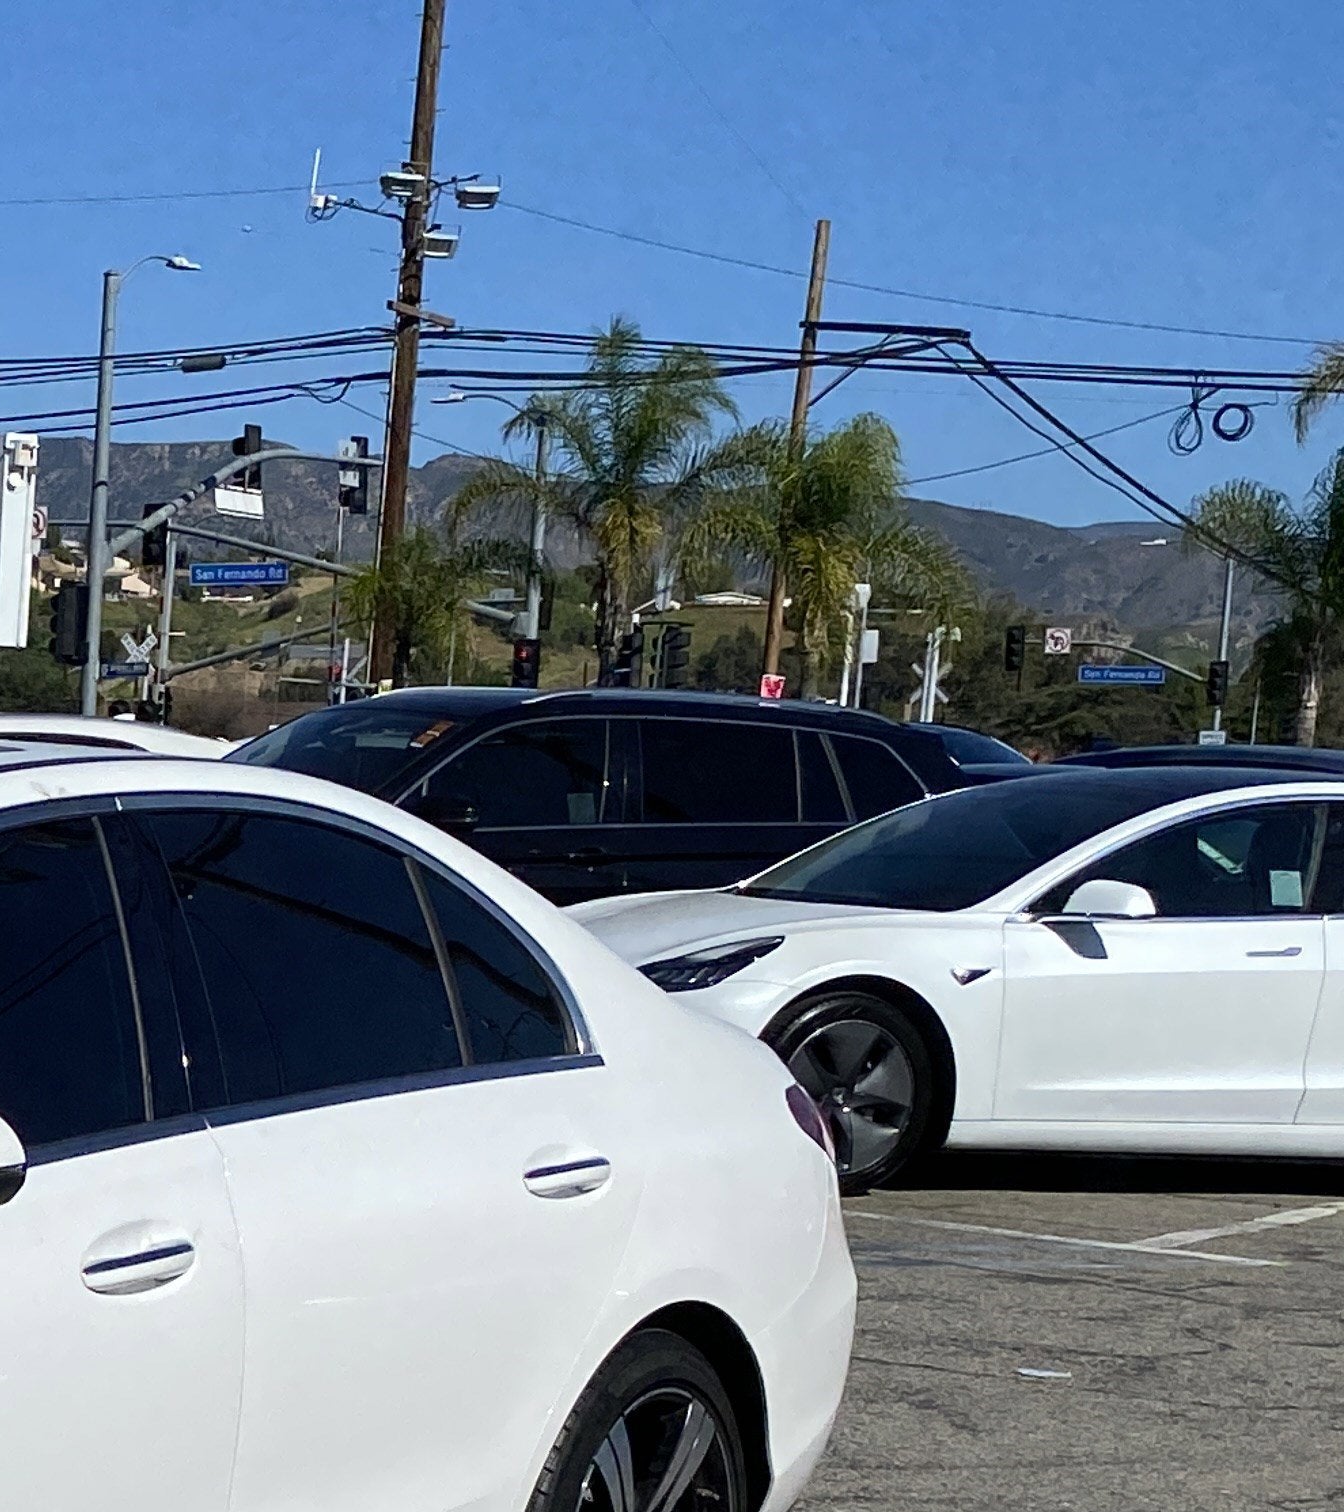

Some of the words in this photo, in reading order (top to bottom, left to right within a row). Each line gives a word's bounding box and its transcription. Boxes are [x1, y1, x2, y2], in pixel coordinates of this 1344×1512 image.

[195, 568, 215, 580] San
[217, 568, 267, 580] Fernando
[268, 566, 284, 579] Rd
